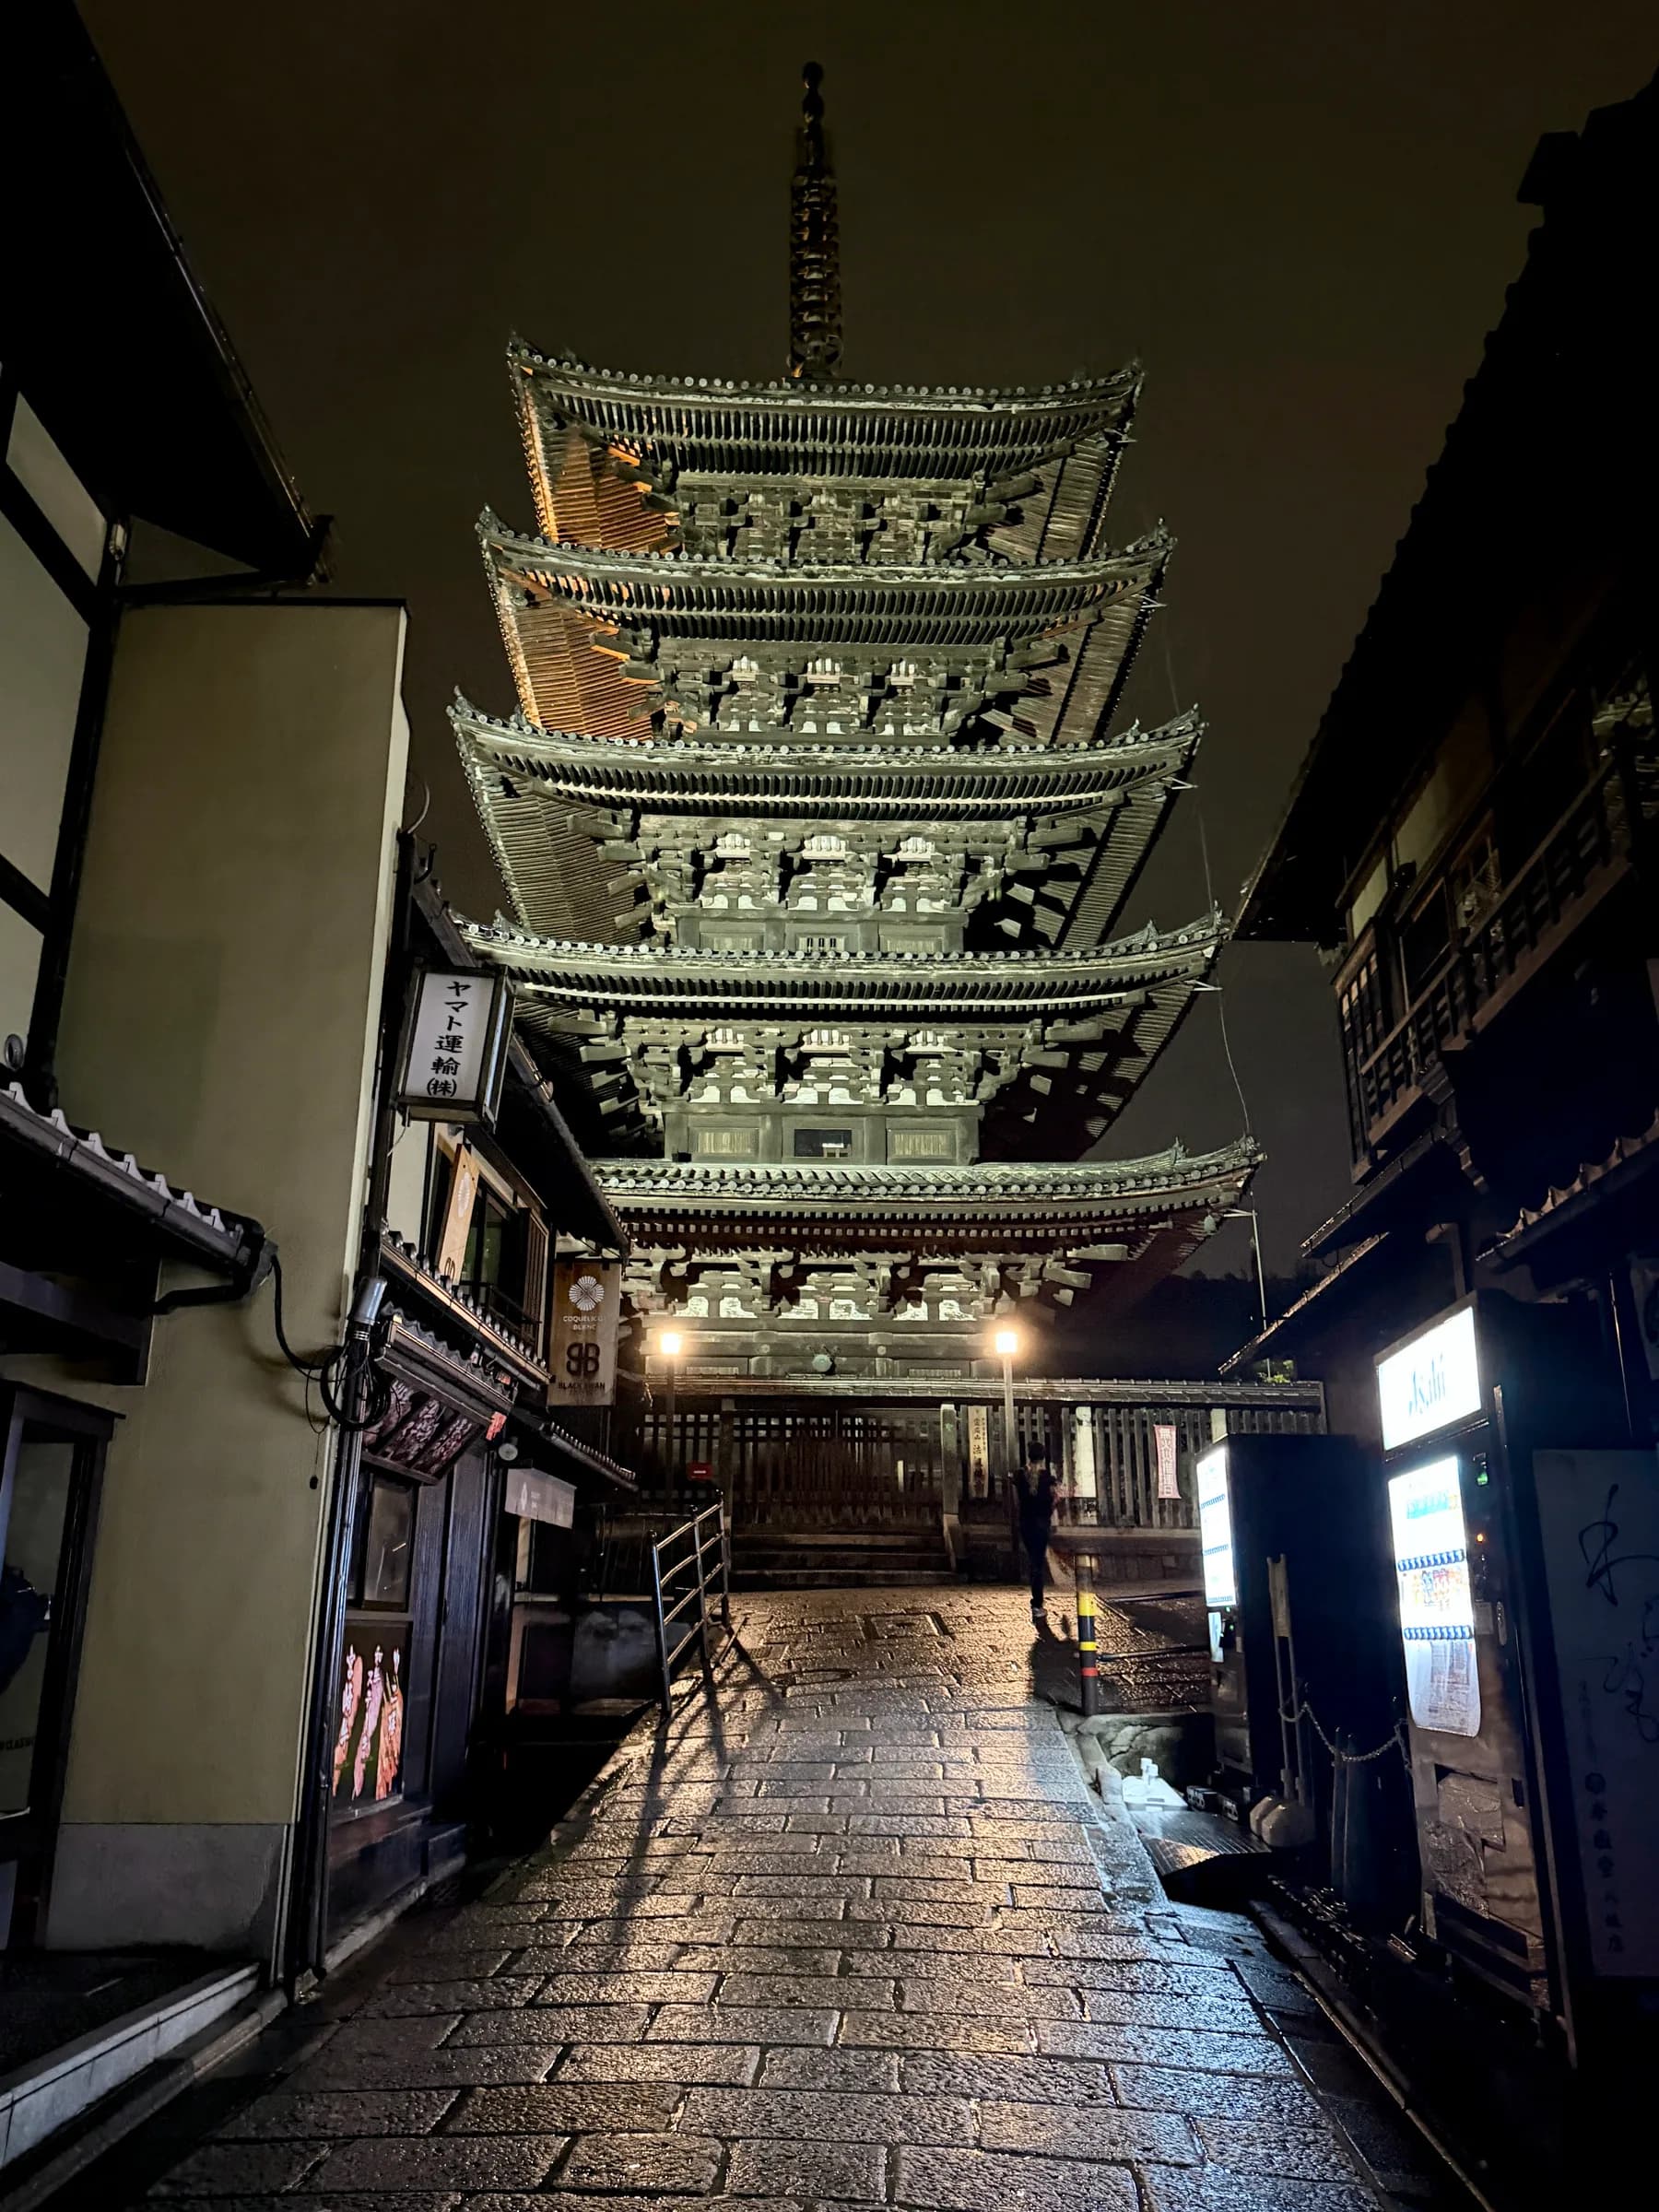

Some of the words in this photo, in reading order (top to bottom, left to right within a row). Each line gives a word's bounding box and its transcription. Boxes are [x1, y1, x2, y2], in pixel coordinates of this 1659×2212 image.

[427, 981, 471, 1097] ヤマト運輸(株)
